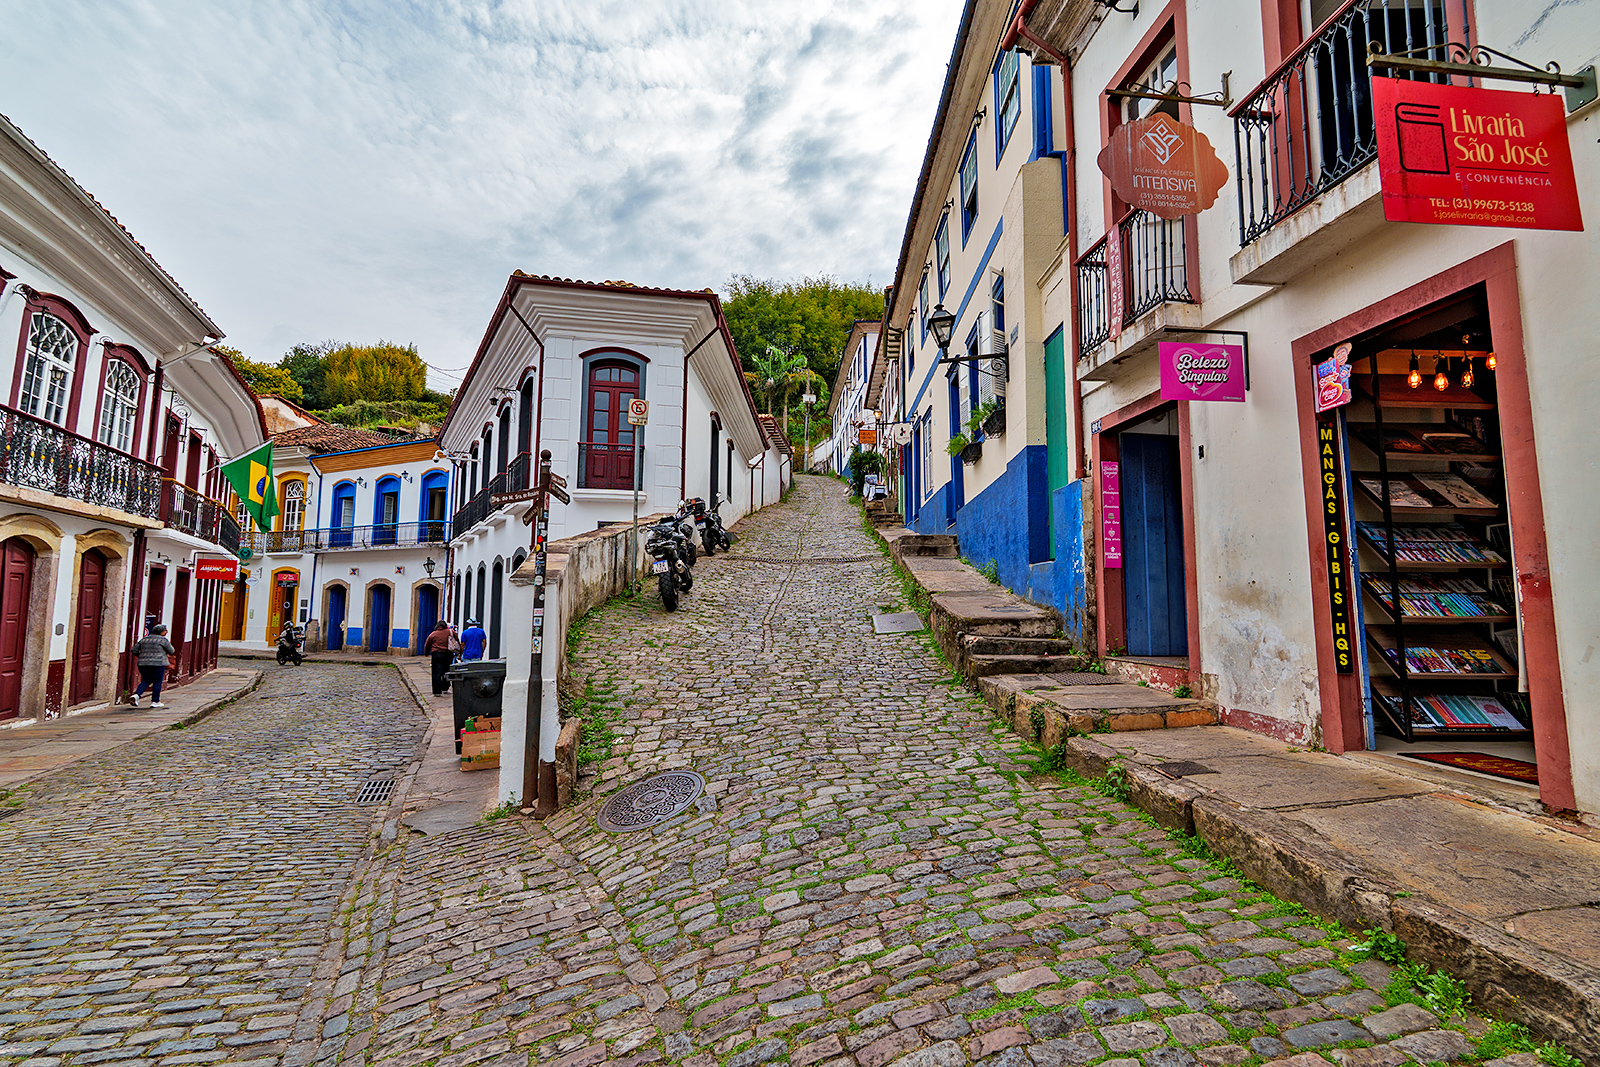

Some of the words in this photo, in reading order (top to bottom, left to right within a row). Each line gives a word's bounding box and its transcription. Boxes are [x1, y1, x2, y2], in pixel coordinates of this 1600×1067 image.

[1449, 107, 1525, 138] Livraria
[1453, 135, 1494, 163] São
[1500, 139, 1550, 167] José
[1132, 175, 1197, 192] INTENSIVA
[1455, 172, 1462, 181] E
[1466, 172, 1552, 187] CONVENIÊNCIA
[1140, 192, 1153, 201] (31)
[1429, 197, 1450, 208] TEL:
[1452, 198, 1472, 210] (31)
[1474, 199, 1535, 212] 99673-5138
[1176, 353, 1229, 371] Beleza
[1178, 368, 1229, 386] Singular
[1320, 428, 1336, 514] MANGÁS
[1328, 531, 1343, 604] GIBIS
[1335, 622, 1349, 666] HQS
